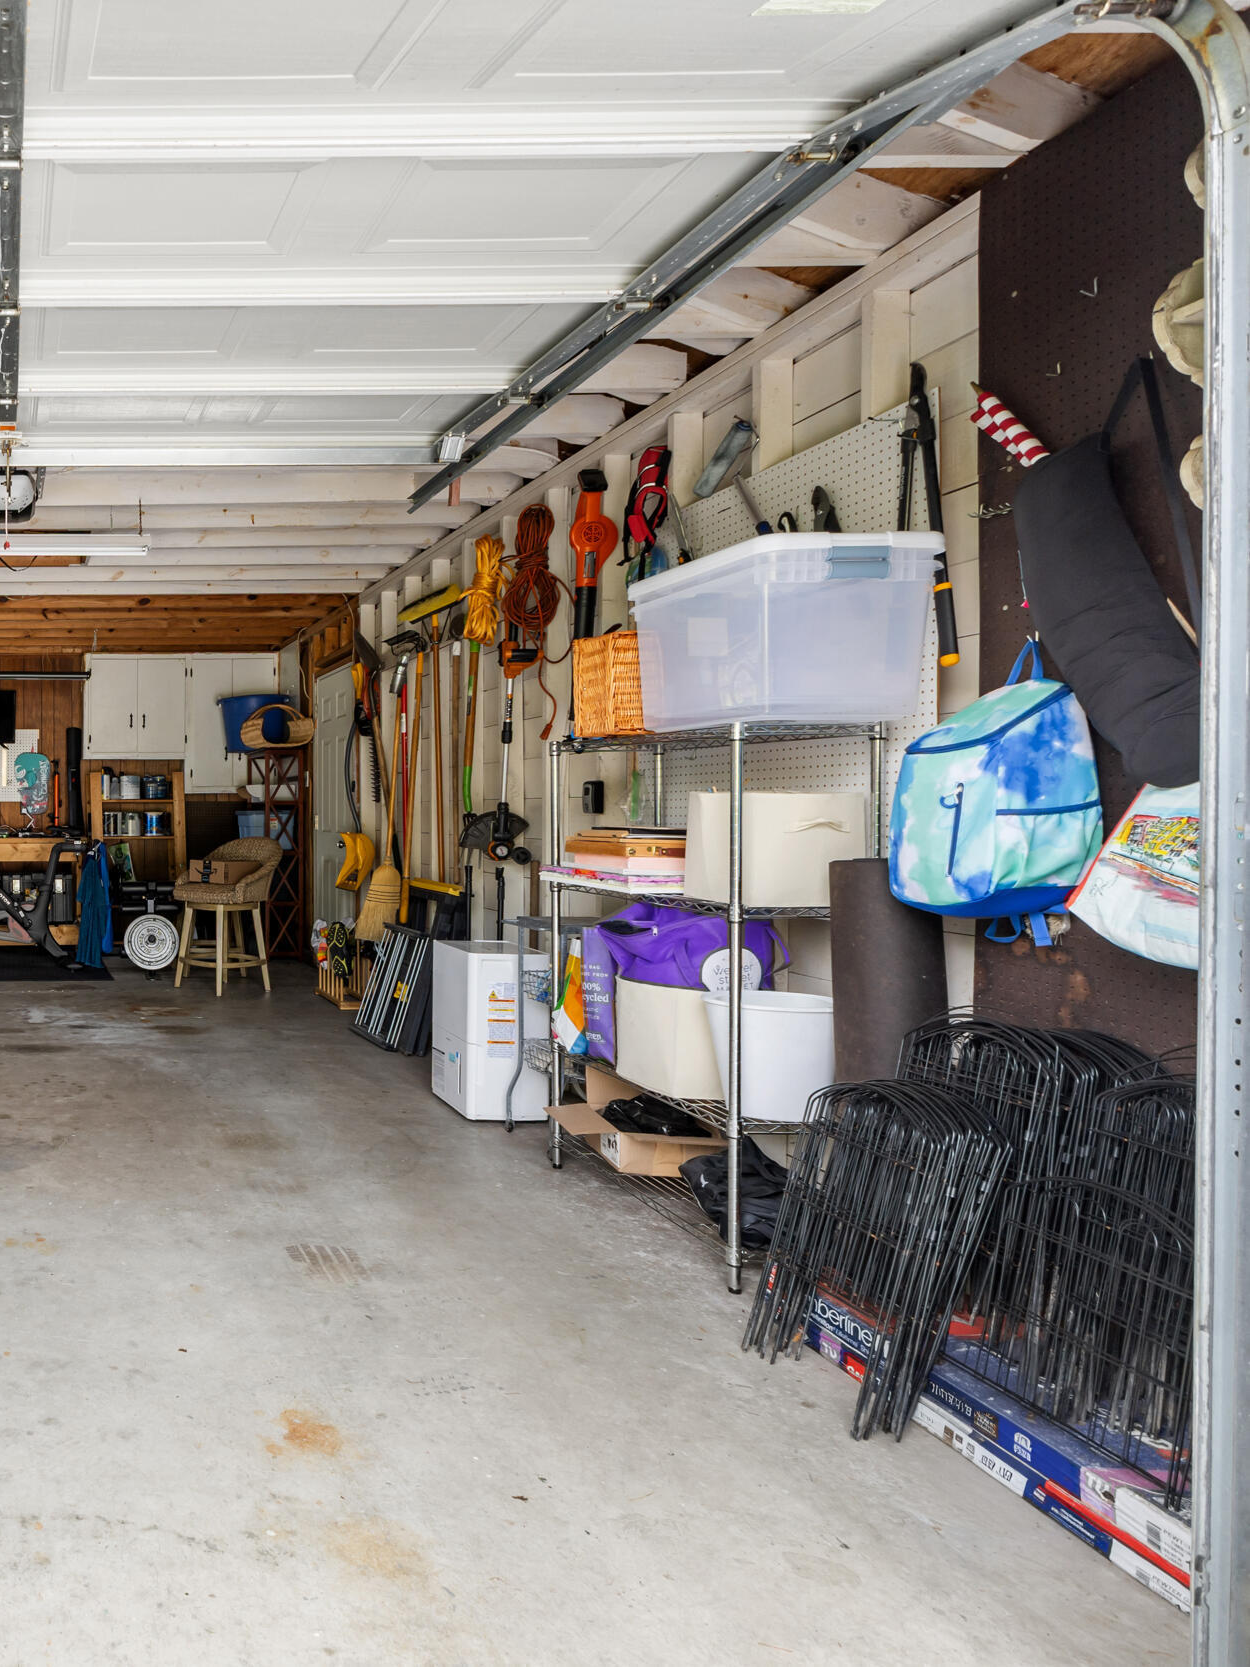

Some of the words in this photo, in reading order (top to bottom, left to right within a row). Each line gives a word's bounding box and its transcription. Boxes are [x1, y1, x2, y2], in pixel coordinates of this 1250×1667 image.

[713, 964, 754, 976] weer
[718, 973, 752, 985] stet
[582, 993, 610, 1003] cycled
[813, 1297, 873, 1348] berline
